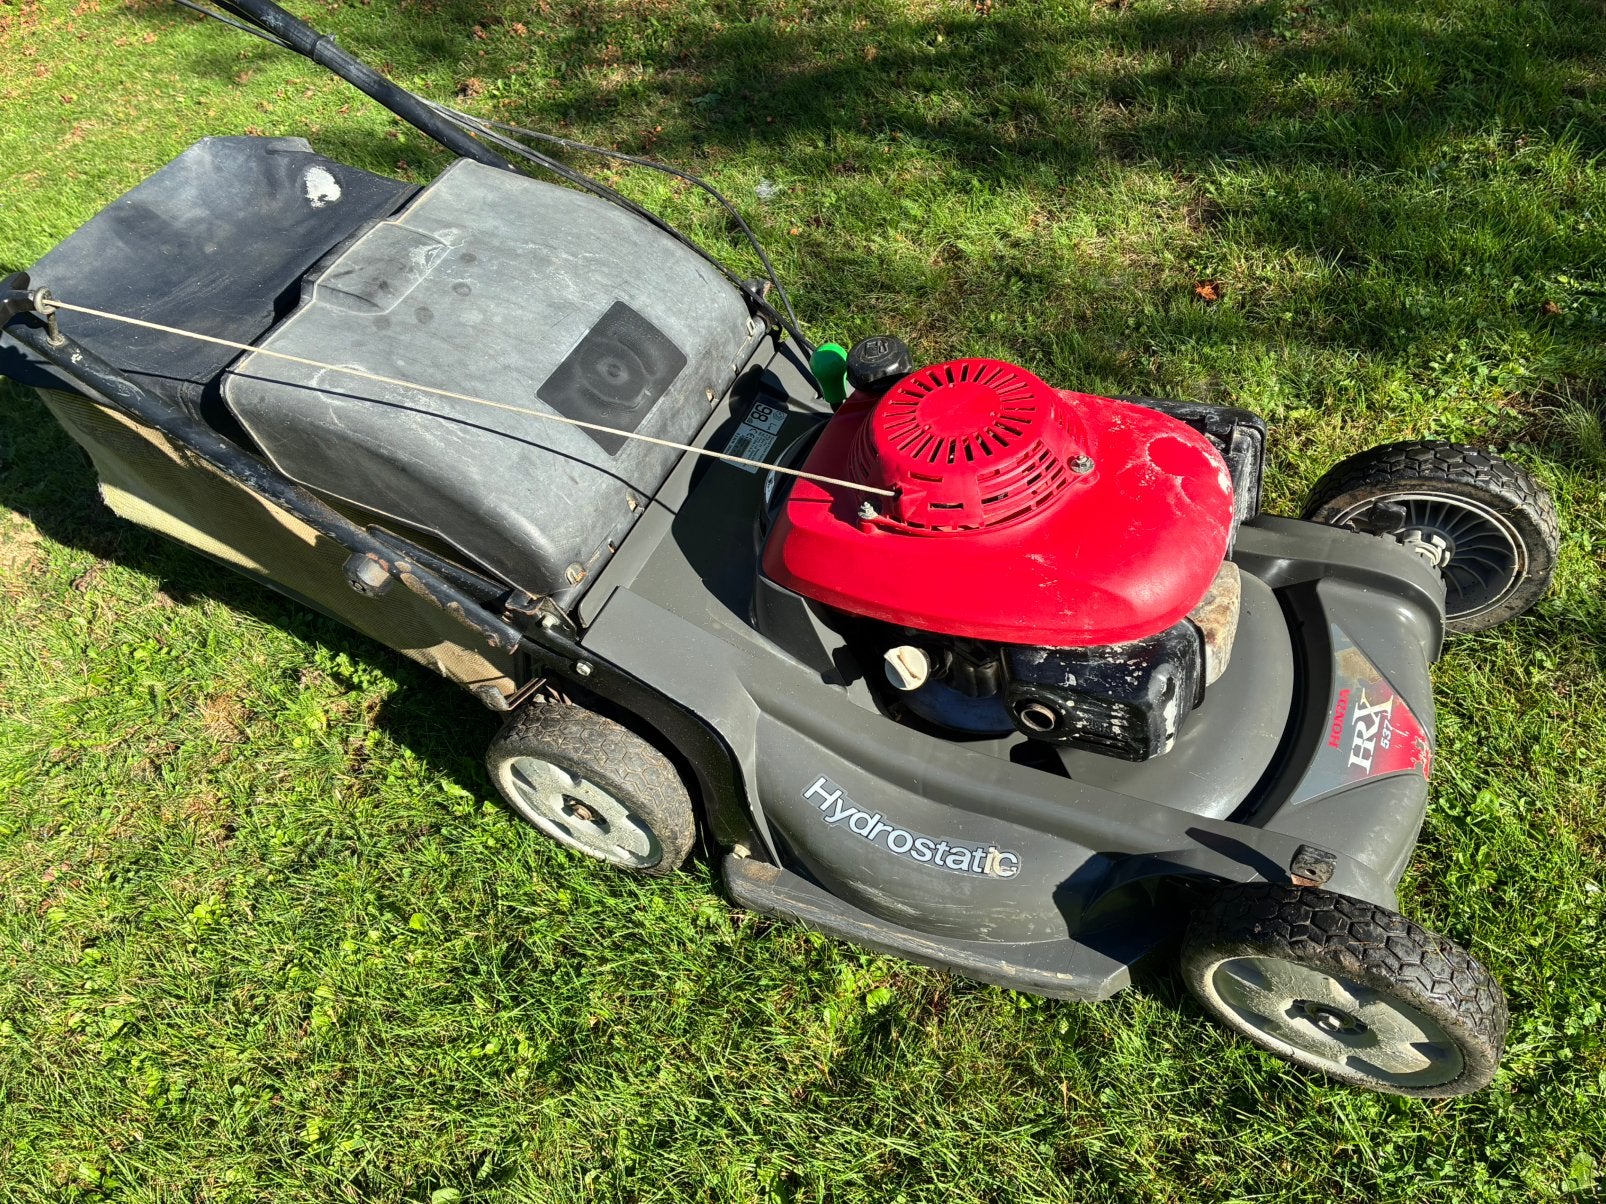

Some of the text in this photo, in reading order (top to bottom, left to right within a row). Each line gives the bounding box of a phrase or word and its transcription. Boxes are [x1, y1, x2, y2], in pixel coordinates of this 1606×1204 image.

[751, 404, 773, 422] 98
[1328, 688, 1351, 749] HONDA
[1348, 687, 1394, 775] HRX
[1380, 719, 1394, 749] 537
[802, 776, 1019, 877] Hydrostatic
